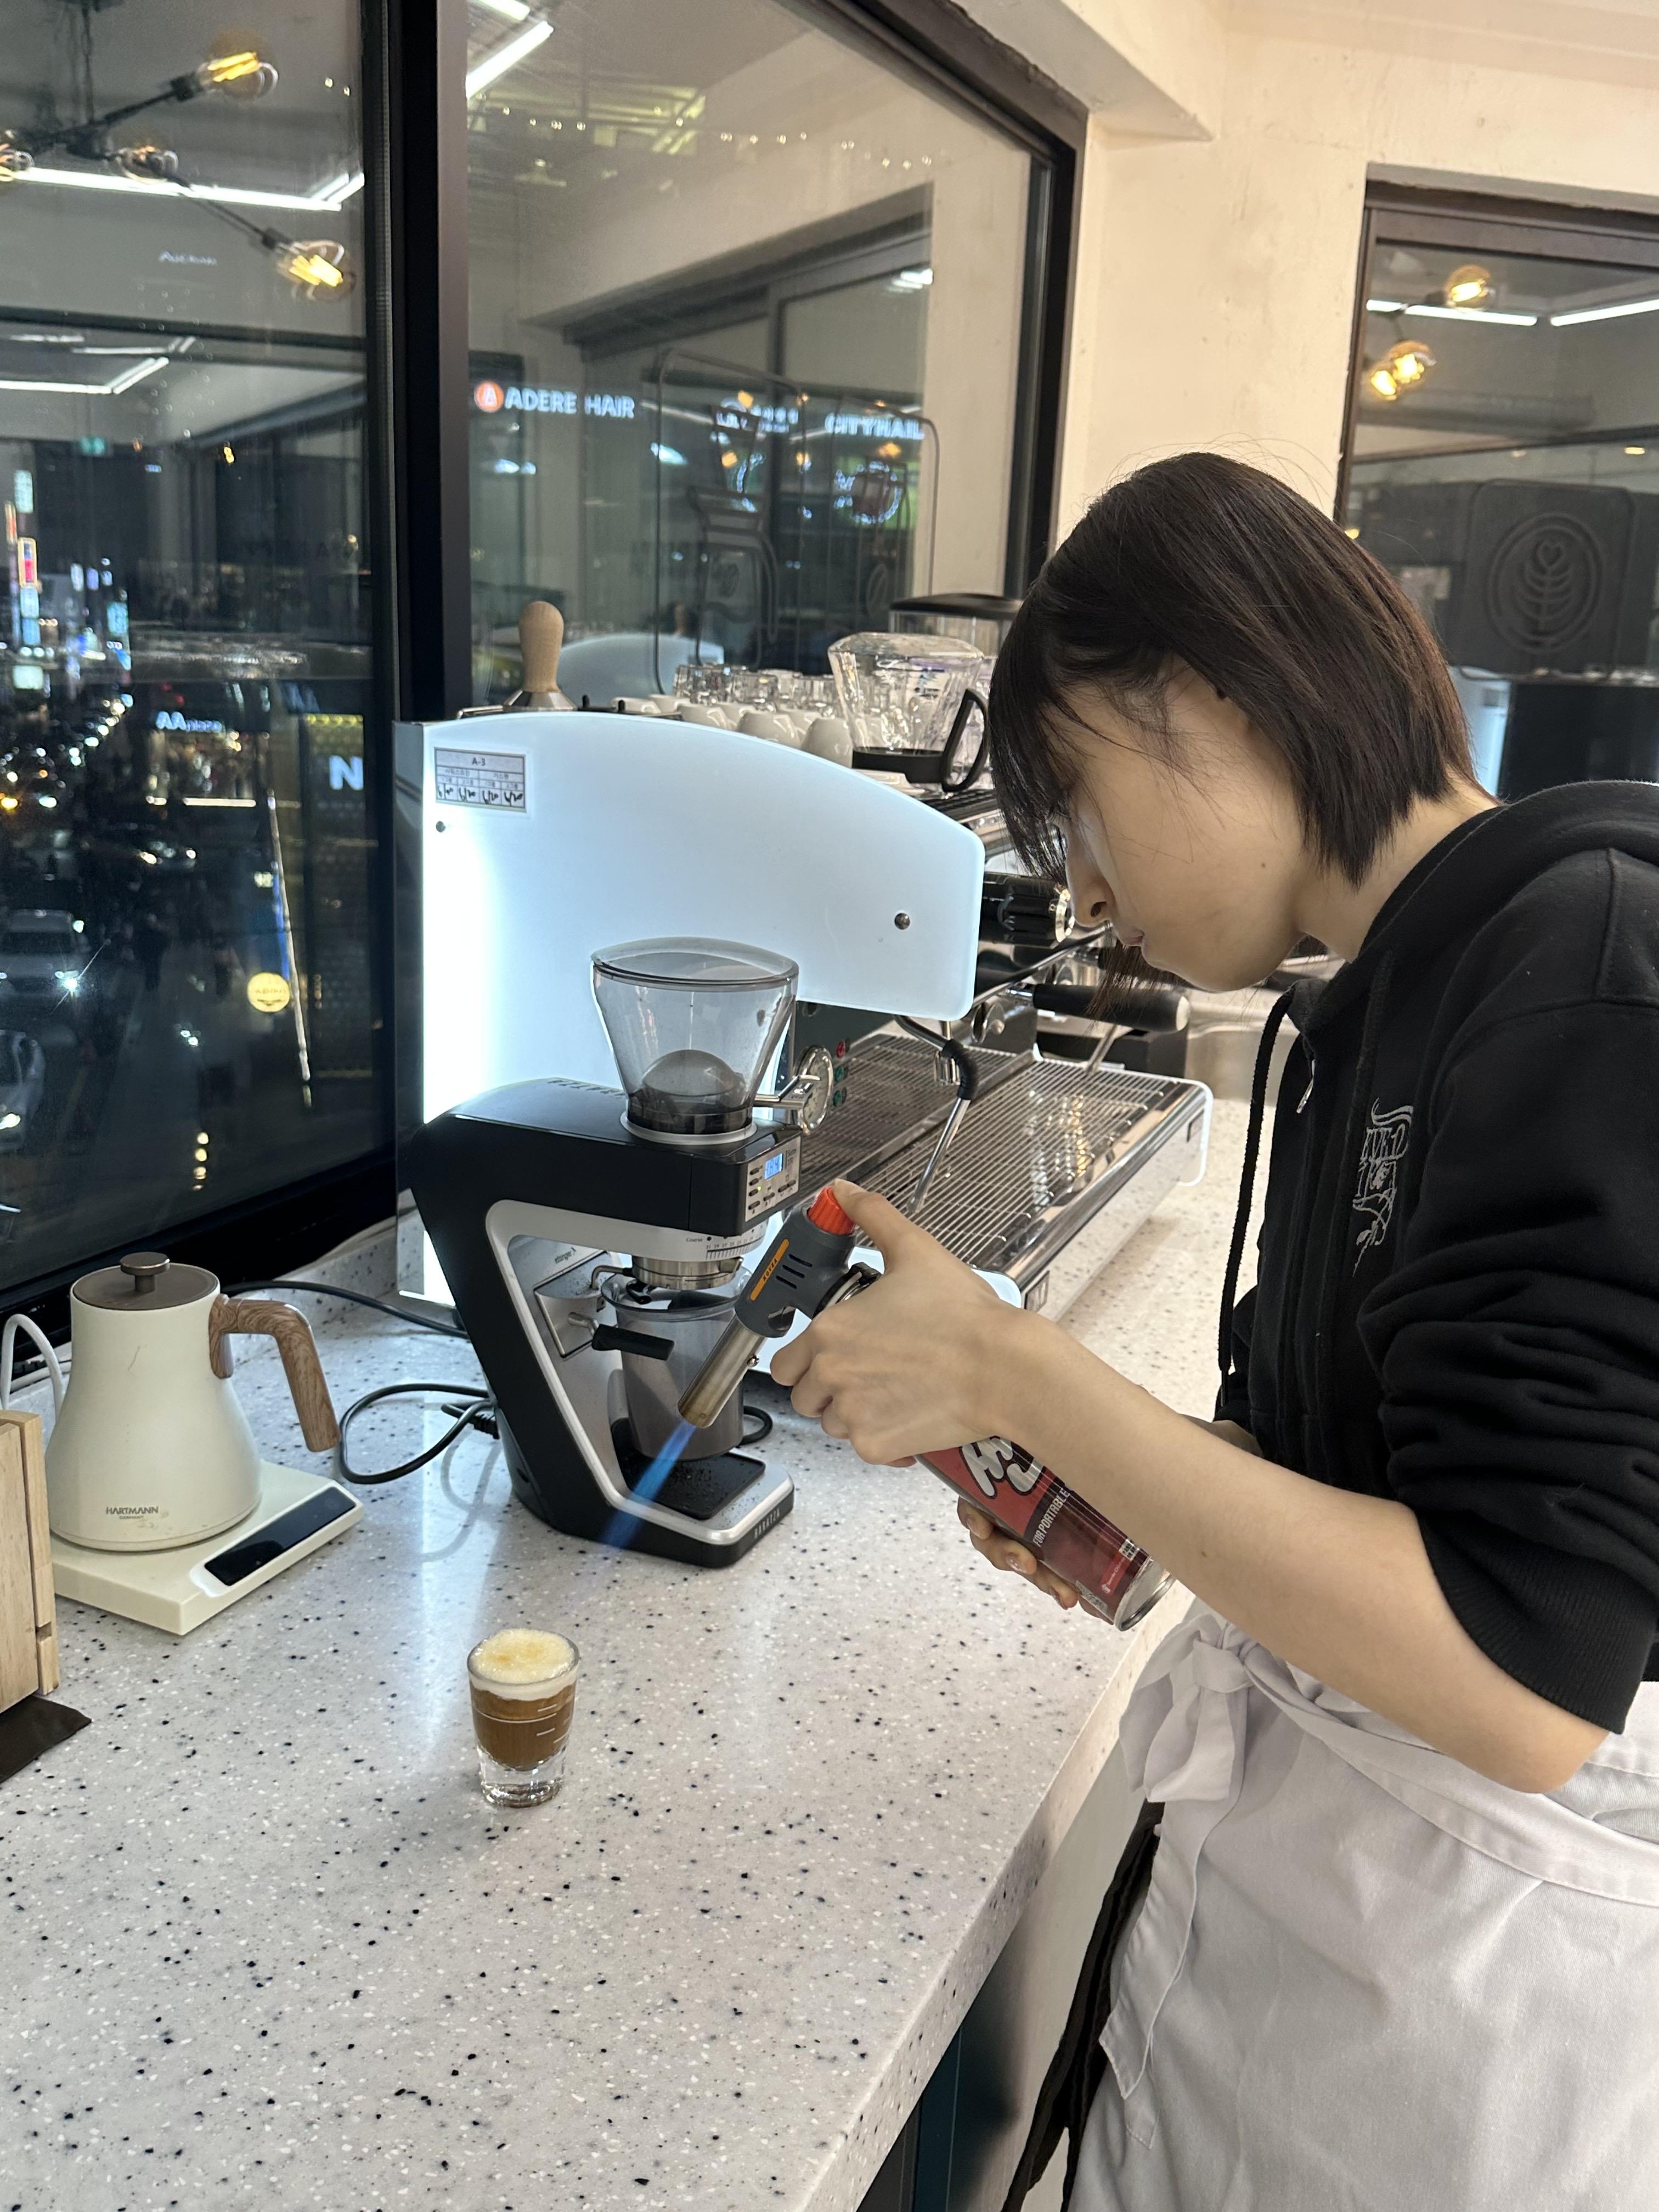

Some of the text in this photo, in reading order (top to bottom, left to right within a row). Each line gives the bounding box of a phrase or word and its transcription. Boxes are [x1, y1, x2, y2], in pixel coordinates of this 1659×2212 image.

[504, 387, 577, 414] ADERE
[584, 393, 634, 418] HAIR
[472, 757, 486, 766] A-3
[763, 1258, 777, 1282] KOVEA
[106, 1506, 159, 1515] HARTMANN
[1032, 1487, 1070, 1547] FOR PORTABLE
